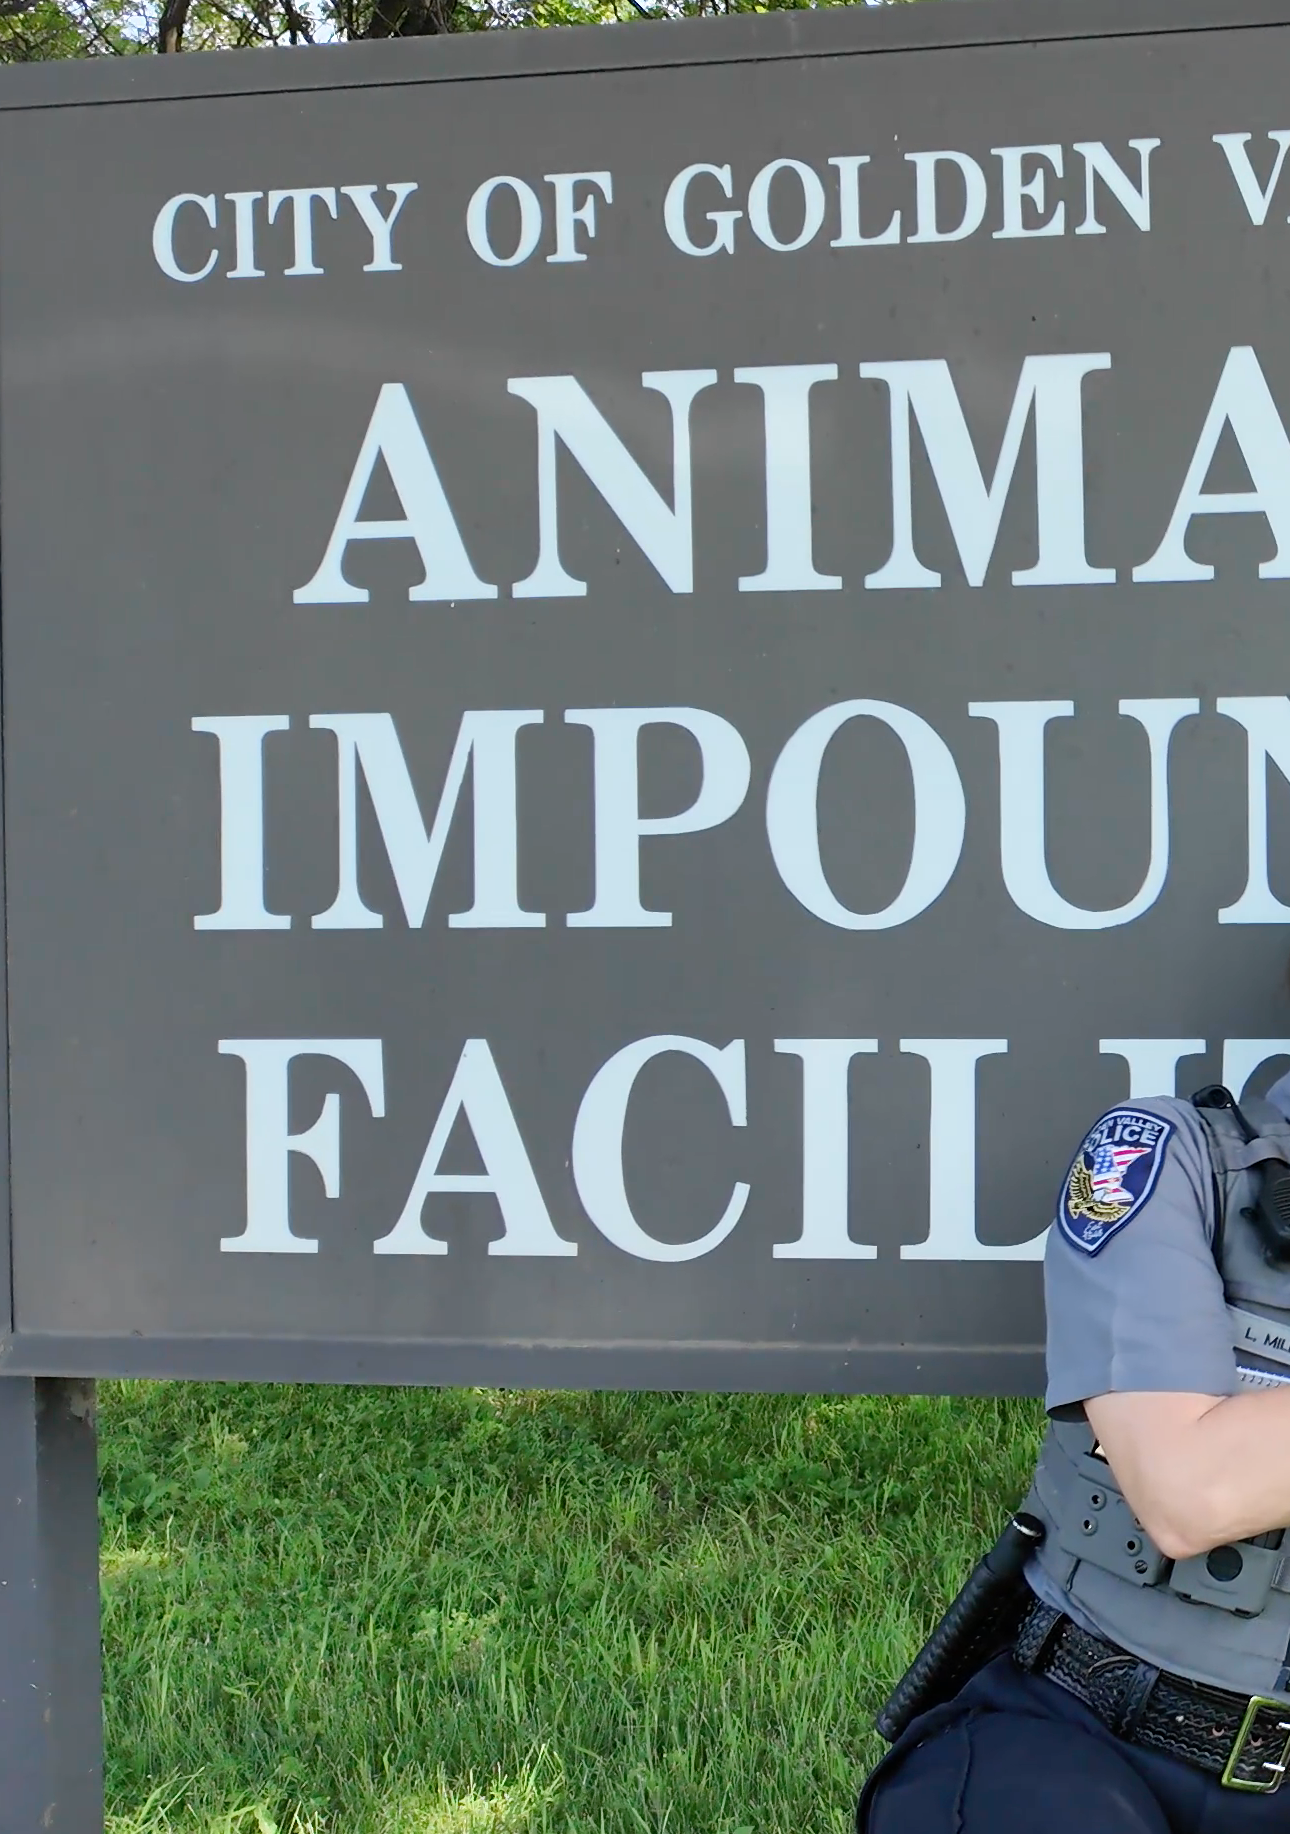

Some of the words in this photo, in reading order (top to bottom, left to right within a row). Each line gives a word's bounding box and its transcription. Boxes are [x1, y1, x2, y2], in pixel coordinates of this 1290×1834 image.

[152, 181, 419, 283] CITY
[466, 170, 614, 267] OF
[663, 137, 1161, 257] GOLDEN
[1244, 1327, 1257, 1342] L.
